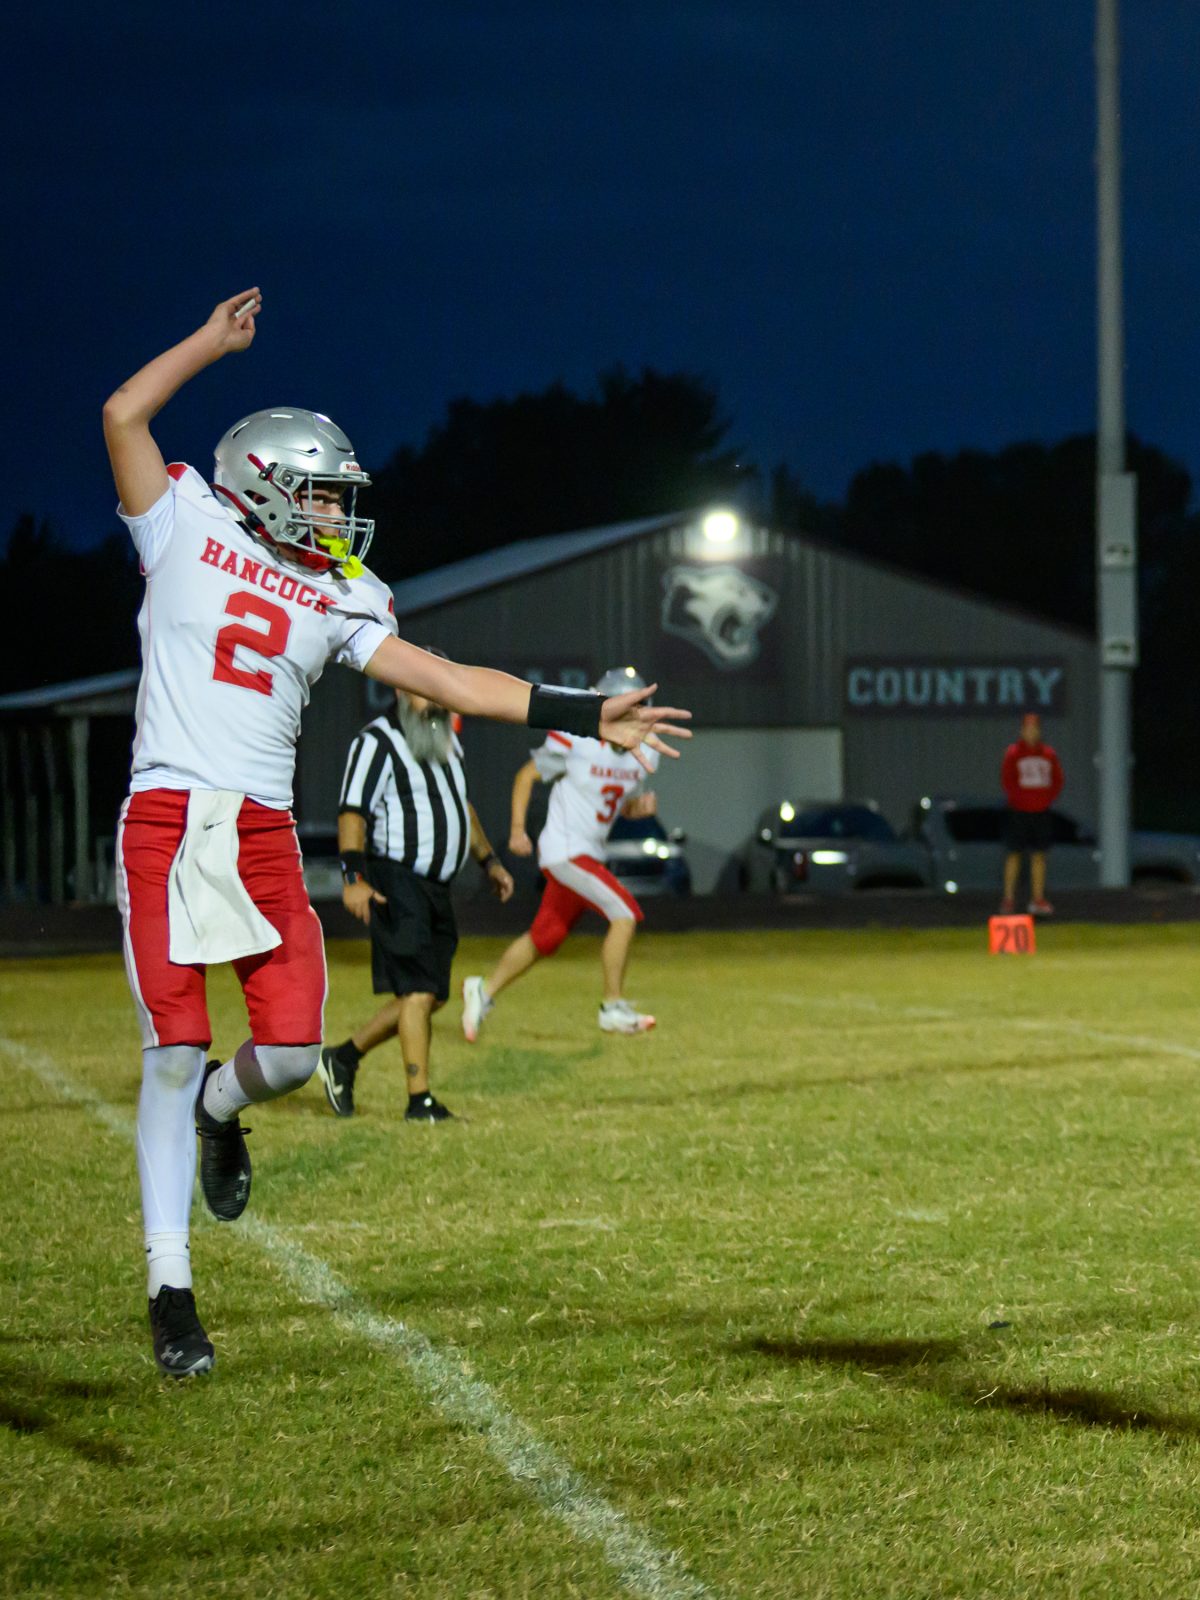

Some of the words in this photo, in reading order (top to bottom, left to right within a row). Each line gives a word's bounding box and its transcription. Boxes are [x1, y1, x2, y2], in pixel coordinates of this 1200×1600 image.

[200, 537, 338, 615] HANCOCK
[213, 590, 292, 697] 2
[848, 667, 1062, 705] COUNTRY
[596, 783, 625, 824] 3
